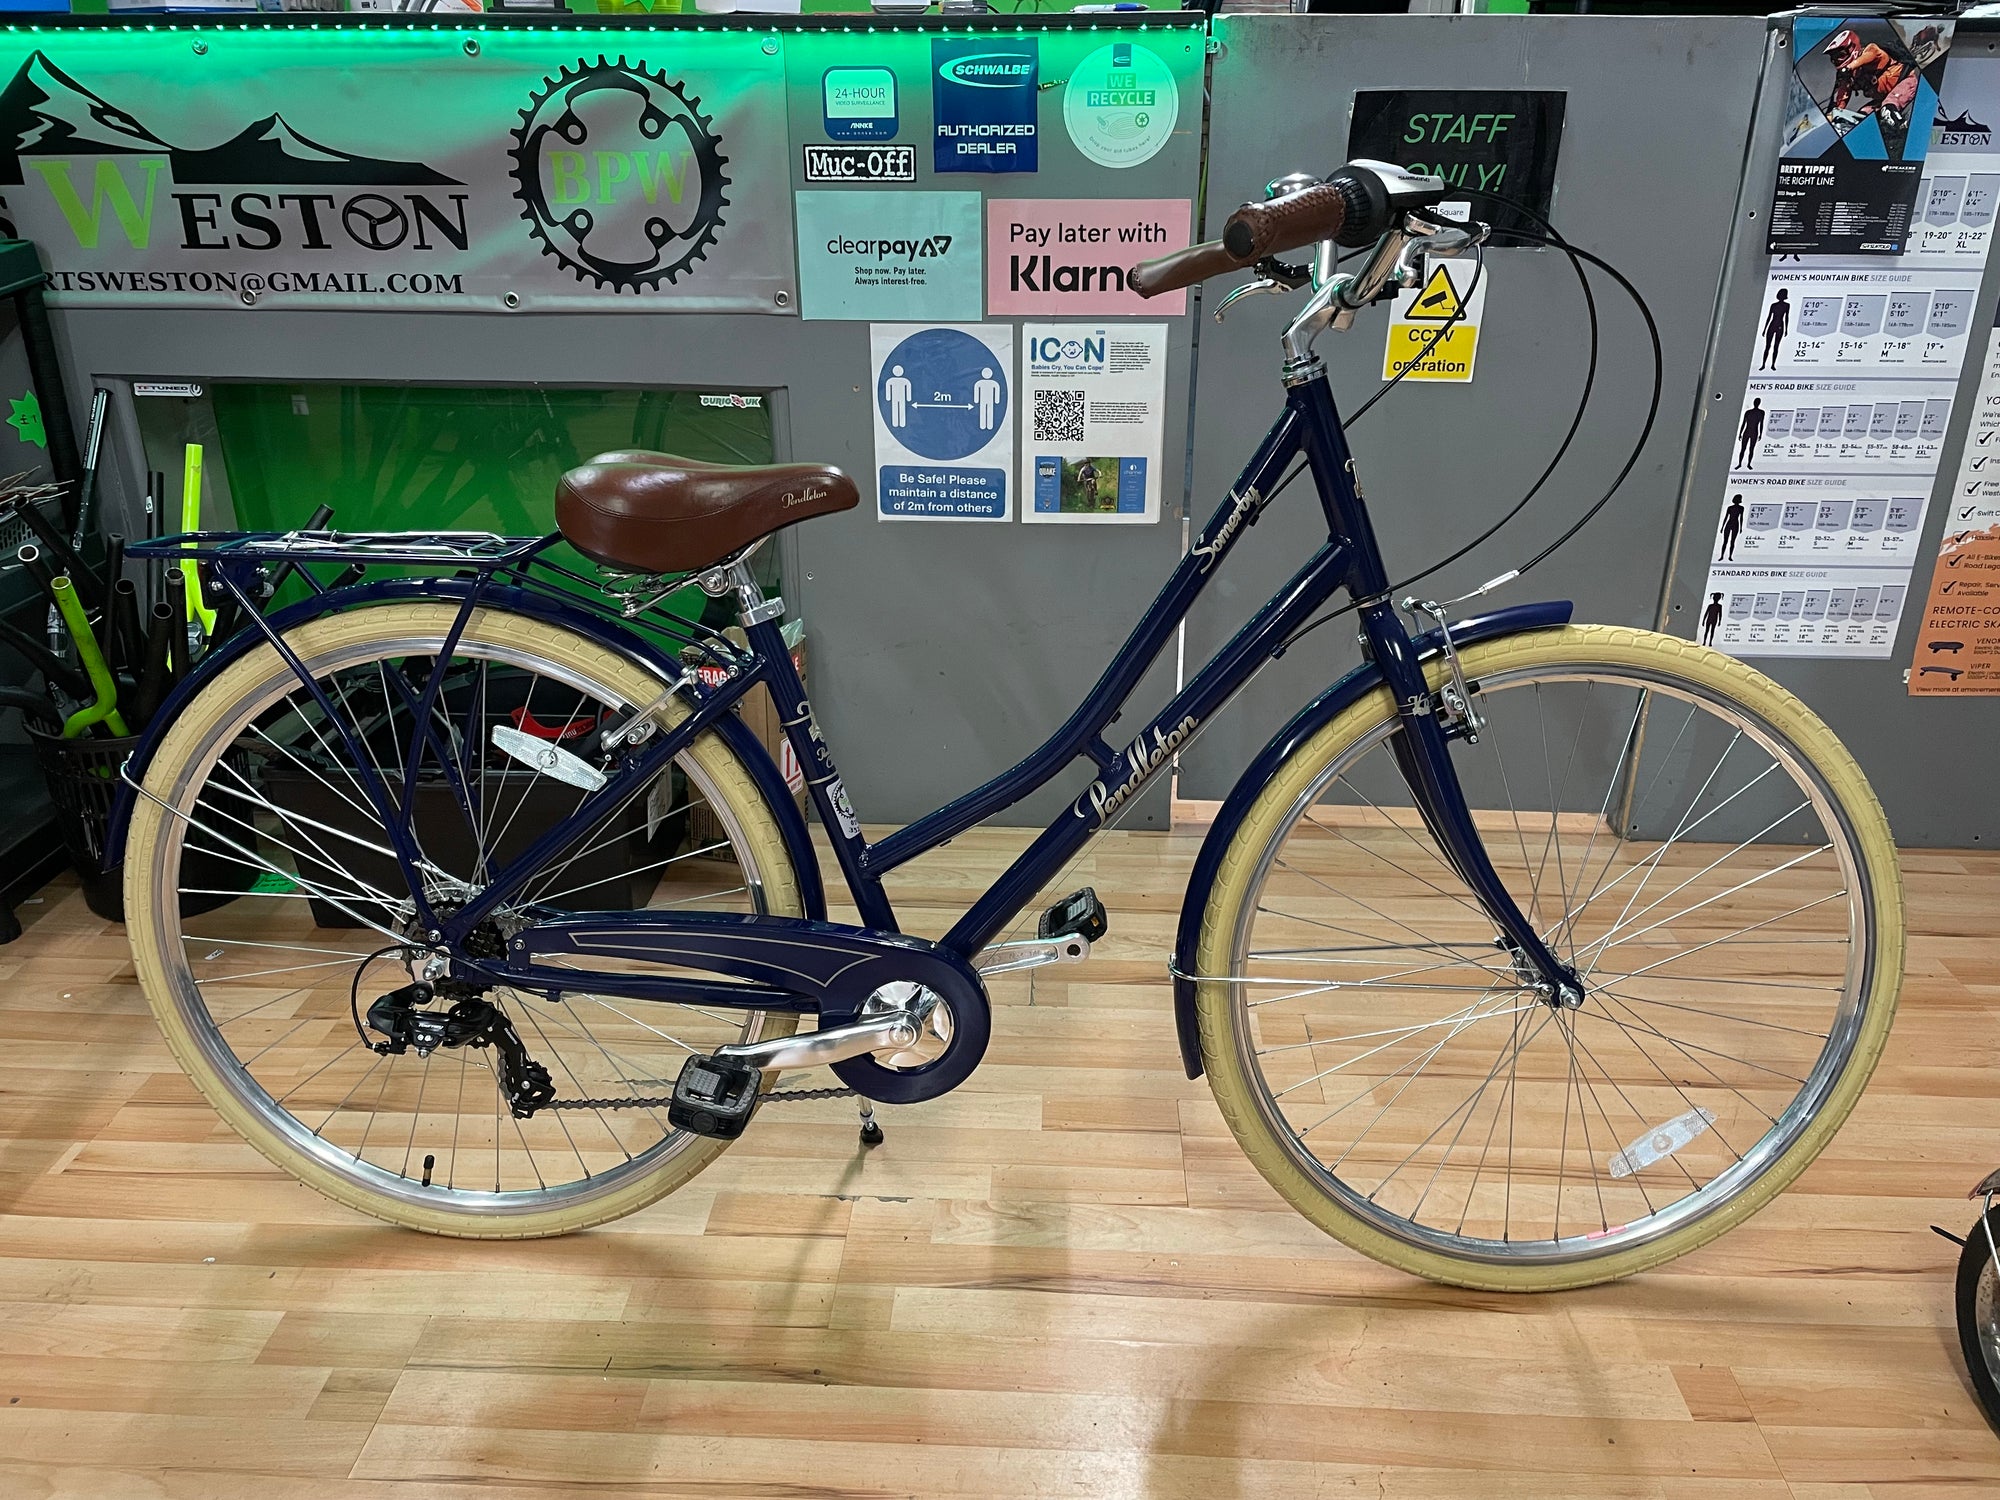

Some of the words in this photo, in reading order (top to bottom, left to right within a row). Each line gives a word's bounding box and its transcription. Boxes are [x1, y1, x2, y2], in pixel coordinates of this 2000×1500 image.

[955, 64, 1031, 76] SCHWALBE
[1110, 74, 1133, 88] WE
[835, 87, 886, 99] 24-HOUR
[1090, 91, 1152, 105] RECYCLE
[938, 124, 1035, 137] AUTHORIZED
[1403, 114, 1516, 144] STAFF
[957, 143, 1016, 154] DEALER
[811, 152, 910, 176] Muc-Off
[1780, 165, 1803, 174] BRETT
[1805, 165, 1835, 174] TIPPIE
[548, 151, 693, 204] BPW
[1779, 176, 1790, 185] THE
[1792, 176, 1816, 186] RIGHT
[1817, 176, 1836, 186] LINE
[29, 158, 469, 251] WESTON
[1439, 208, 1464, 216] Square
[1009, 222, 1052, 248] Pay
[1058, 222, 1111, 243] later
[1117, 222, 1167, 243] with
[827, 235, 919, 261] clearpay
[1921, 240, 1927, 248] L
[1956, 240, 1967, 248] XL
[854, 266, 873, 275] Shop
[875, 267, 891, 275] now.
[893, 266, 906, 276] Pay
[908, 266, 927, 275] later.
[854, 276, 879, 286] Always
[880, 276, 928, 285] interest-free.
[1771, 274, 1807, 282] WOMEN'S
[1808, 274, 1849, 282] MOUNTAIN
[1889, 275, 1913, 283] GUIDE
[1408, 329, 1454, 342] CCTV
[1031, 337, 1104, 363] ICON
[1423, 344, 1435, 357] in
[1923, 350, 1929, 358] L
[1051, 364, 1062, 372] Cry,
[1087, 364, 1104, 372] Cope!
[1392, 360, 1466, 375] operation
[1750, 383, 1773, 391] MEN'S
[1774, 383, 1795, 391] ROAD
[745, 397, 760, 406] UK
[933, 392, 951, 402] 2m
[899, 473, 915, 484] Be
[917, 473, 946, 485] Safe!
[949, 475, 987, 486] Please
[1730, 478, 1765, 486] WOMEN'S
[1825, 479, 1847, 487] GUIDE
[781, 487, 827, 508] Pendleton
[888, 487, 937, 499] maintain
[939, 490, 947, 499] a
[949, 488, 997, 500] distance
[893, 501, 905, 511] of
[907, 502, 925, 512] 2m
[927, 502, 953, 512] from
[956, 503, 993, 513] others
[1192, 486, 1261, 574] Somerby
[1929, 620, 1981, 629] ELECTRIC
[1983, 620, 2000, 629] SK
[1976, 637, 2000, 645] VENO
[1970, 662, 1991, 670] VIPER
[1074, 715, 1199, 833] Pendleton
